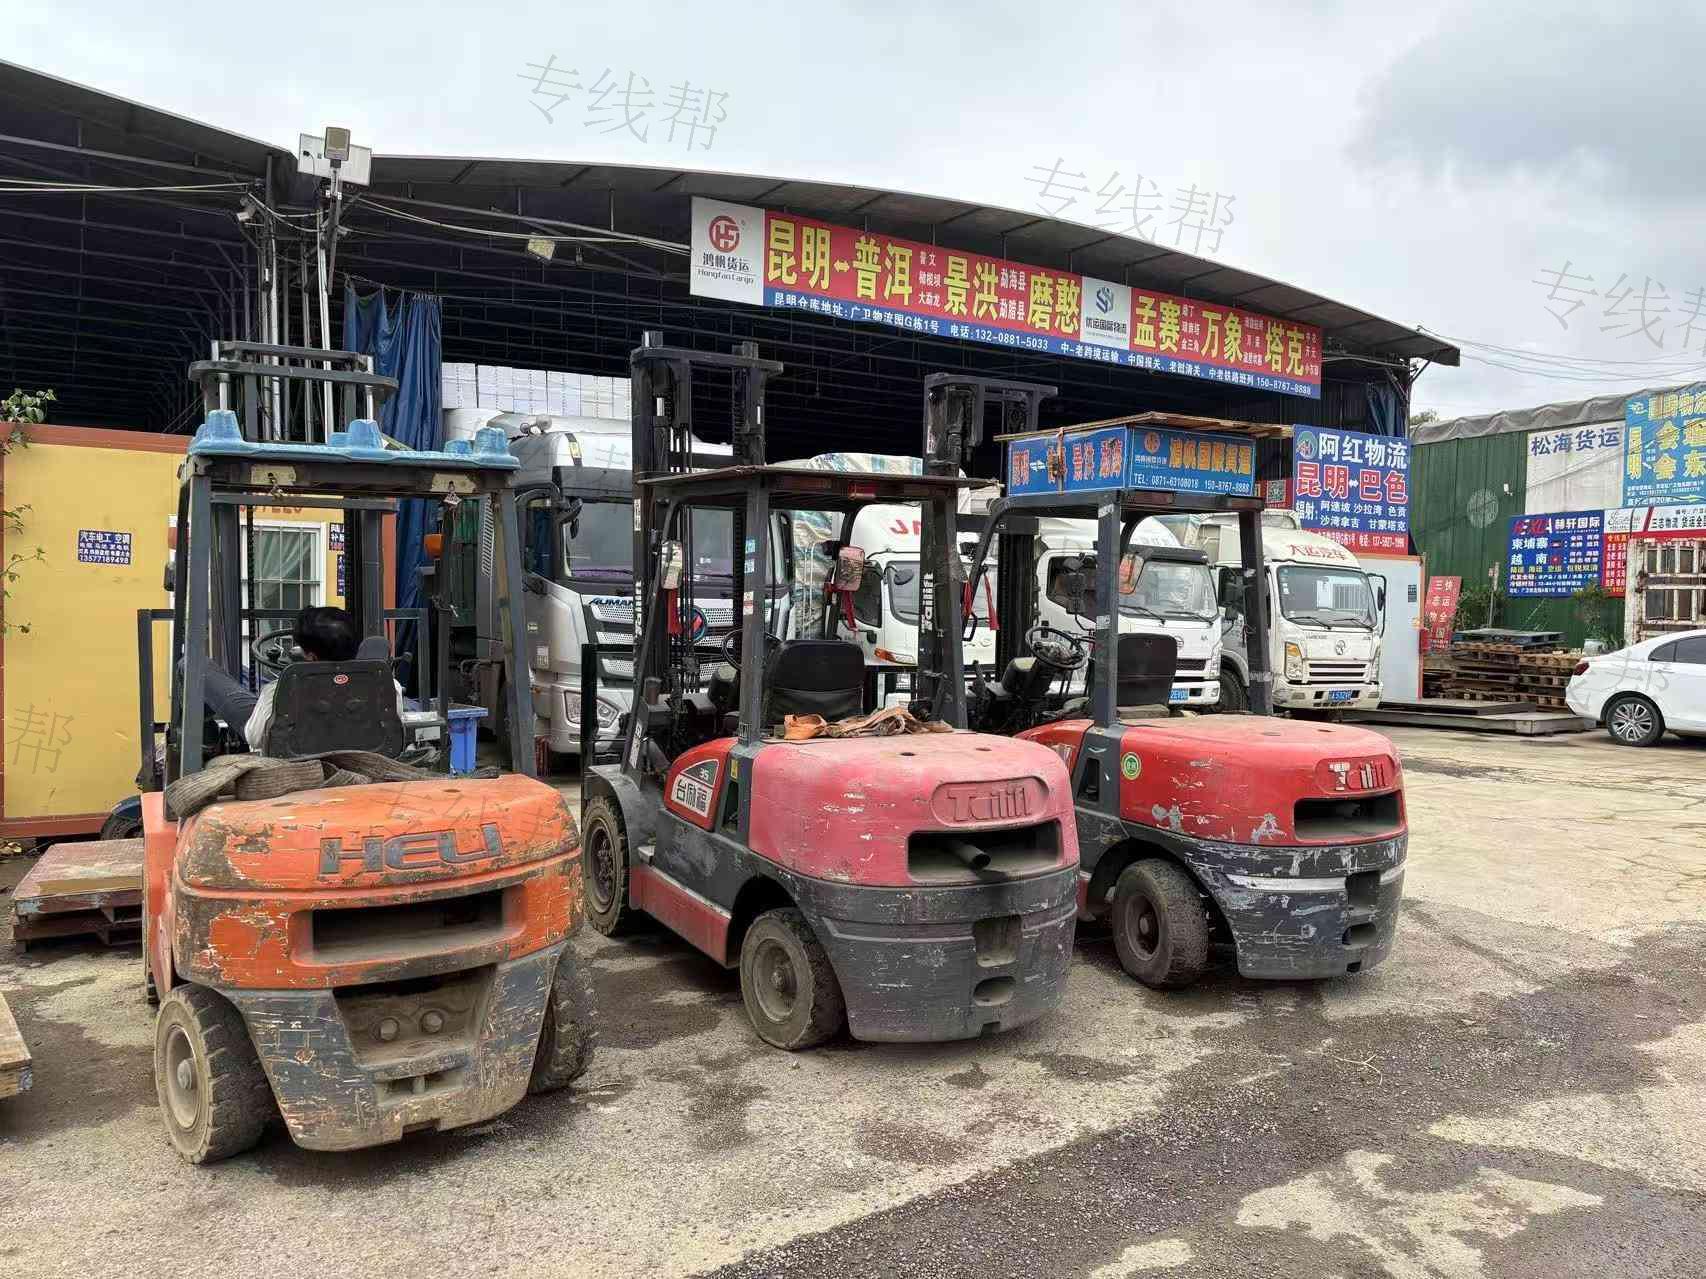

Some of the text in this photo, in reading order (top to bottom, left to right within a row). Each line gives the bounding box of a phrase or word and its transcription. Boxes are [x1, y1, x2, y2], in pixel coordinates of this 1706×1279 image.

[767, 218, 1081, 334] 昆明 普洱 景洪 磨憨
[1000, 267, 1027, 292] 勐海县
[1133, 295, 1182, 354] 孟赛
[1200, 310, 1244, 364] 万象
[1265, 319, 1305, 378] 塔克
[1318, 432, 1408, 469] 阿红物流
[1530, 427, 1620, 457] 松海货运
[1296, 461, 1408, 504] 昆明 巴色
[1295, 499, 1319, 521] 辐射:
[1320, 515, 1360, 529] 沙湾拿吉
[1353, 503, 1383, 515] 沙拉湾
[80, 531, 130, 545] 汽车电工 空调
